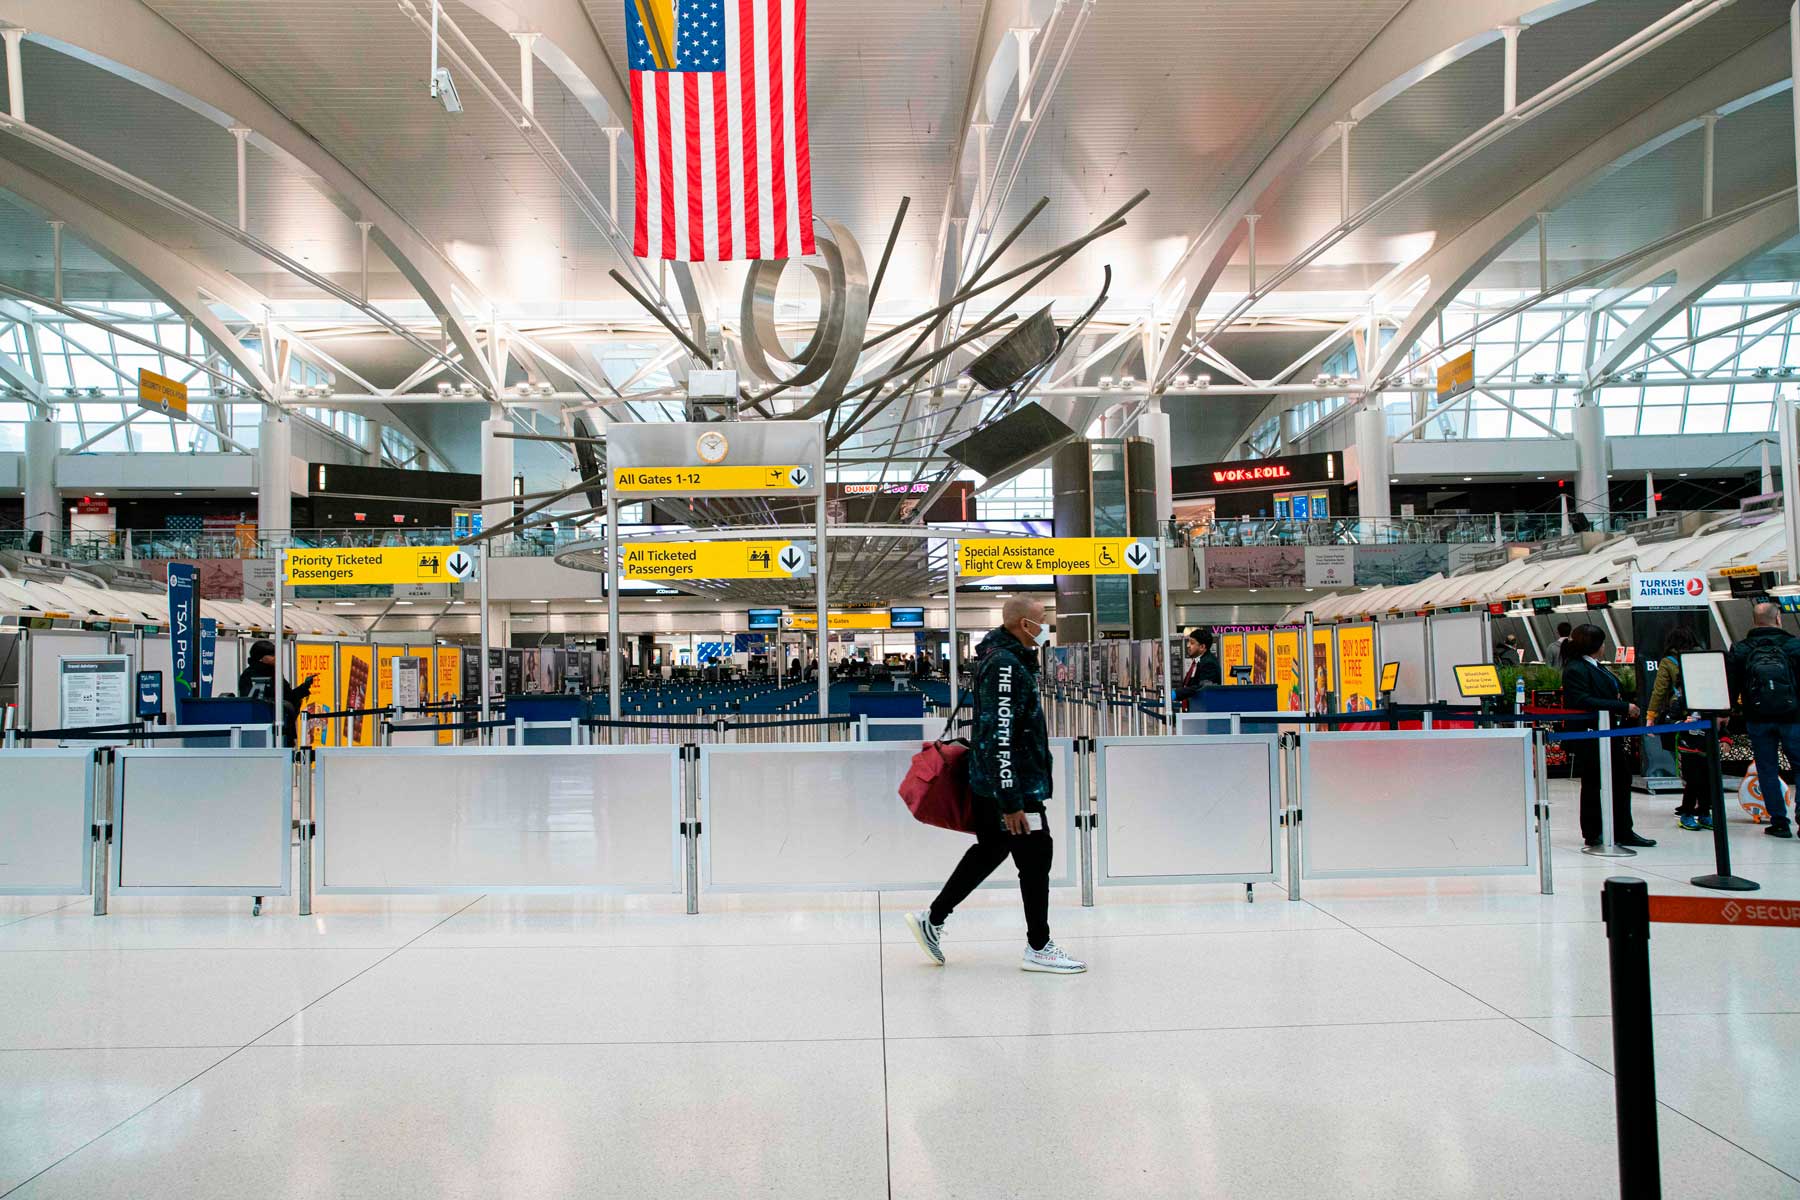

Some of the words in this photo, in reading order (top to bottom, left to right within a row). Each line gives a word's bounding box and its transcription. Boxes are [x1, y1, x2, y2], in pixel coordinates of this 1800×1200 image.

[619, 474, 635, 485] All
[638, 474, 672, 485] Gates
[676, 474, 701, 484] 1-12
[628, 550, 645, 561] All
[647, 550, 697, 561] Ticketed
[964, 546, 1000, 559] Special
[1002, 545, 1055, 557] Assistance
[292, 555, 333, 568] Priority
[336, 554, 383, 565] Ticketed
[965, 559, 994, 573] Flight
[996, 559, 1023, 570] Crew
[1025, 559, 1034, 570] &
[1036, 558, 1090, 572] Employees
[292, 568, 354, 581] Passengers
[628, 563, 694, 577] Passengers
[1640, 579, 1685, 588] TURKISH
[1640, 587, 1685, 596] AIRLINES
[177, 601, 188, 635] TSA
[177, 640, 187, 670] Pre
[1343, 639, 1353, 657] BUY
[1360, 638, 1370, 657] GET
[301, 655, 312, 670] BUY
[319, 655, 330, 670] GET
[1349, 659, 1362, 677] FREE
[998, 665, 1012, 693] THE
[998, 696, 1012, 747] NORTH
[998, 751, 1013, 789] FACE
